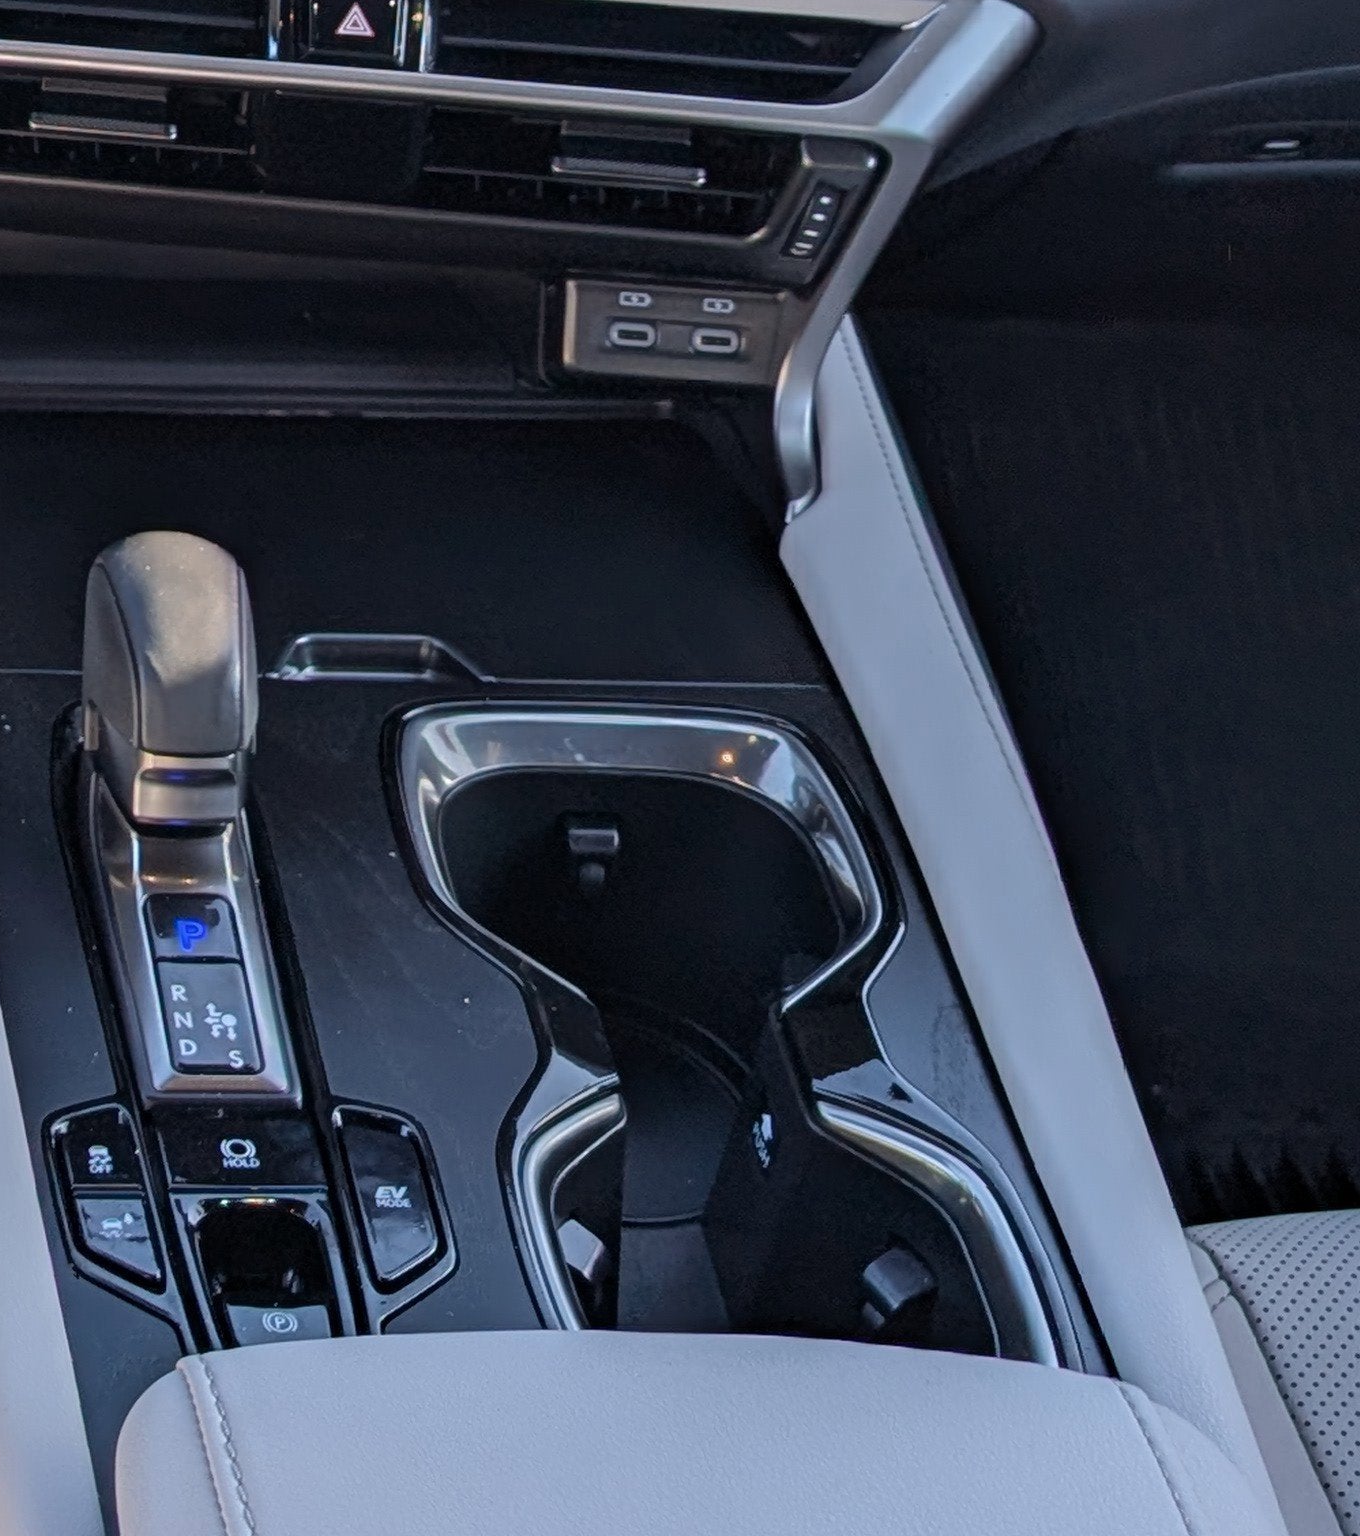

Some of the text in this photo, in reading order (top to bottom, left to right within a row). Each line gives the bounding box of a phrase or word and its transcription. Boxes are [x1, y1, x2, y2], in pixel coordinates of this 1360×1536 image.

[174, 918, 206, 951] P
[170, 984, 189, 1002] R
[173, 1011, 194, 1029] N
[178, 1038, 198, 1057] D
[228, 1049, 245, 1069] S
[88, 1163, 114, 1175] OFF
[222, 1156, 261, 1169] HOLD
[374, 1185, 407, 1199] EV
[375, 1198, 412, 1209] MODE
